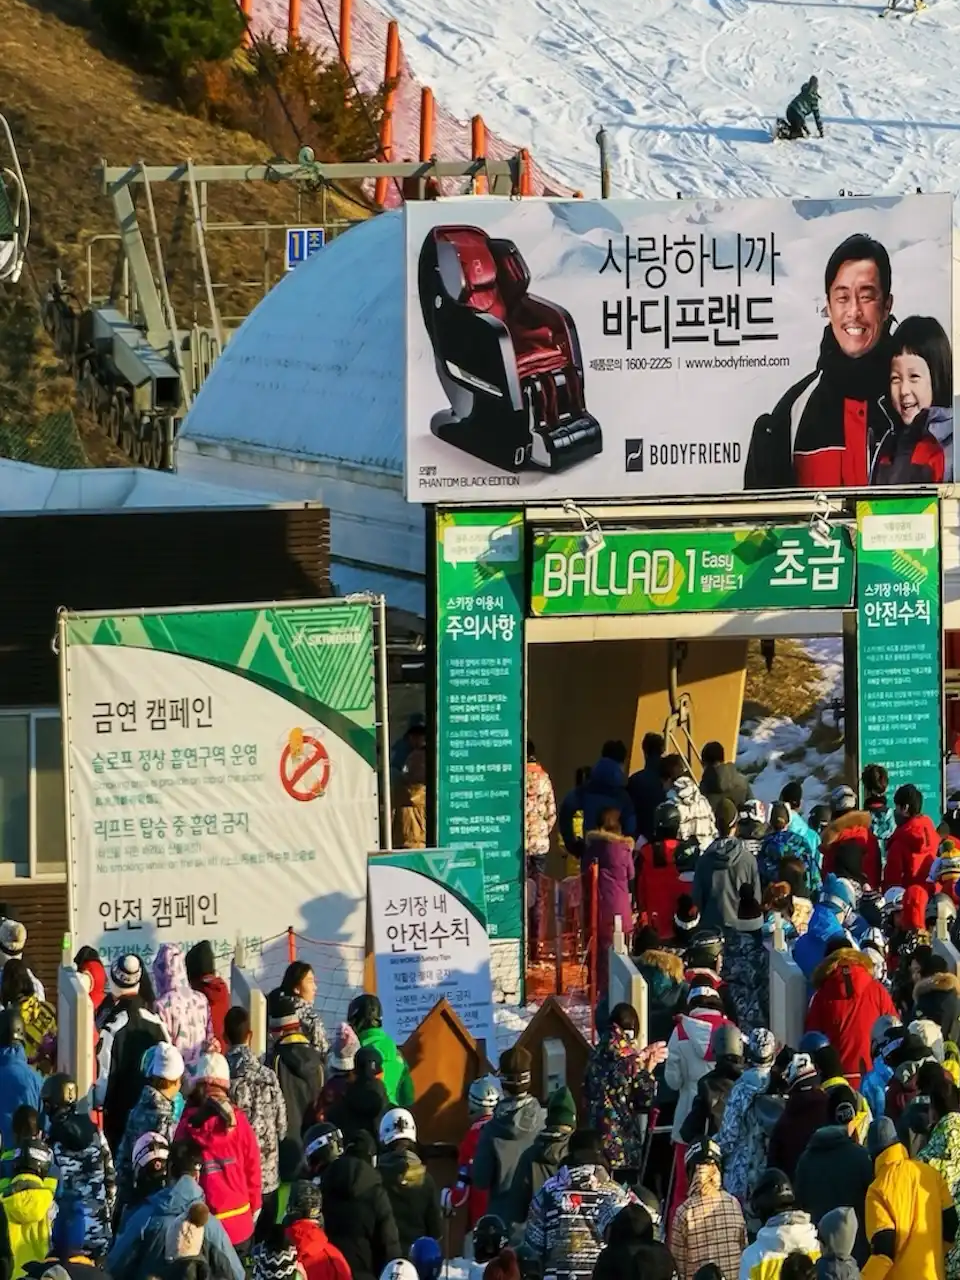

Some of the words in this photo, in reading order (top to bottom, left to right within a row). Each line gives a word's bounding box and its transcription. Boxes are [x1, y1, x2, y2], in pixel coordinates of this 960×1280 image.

[599, 232, 781, 289] 사랑하니까
[602, 293, 779, 351] 바디프랜드
[625, 356, 673, 370] 1600-2225
[685, 354, 790, 370] www.bodyfriend.com
[650, 442, 742, 466] BODYFRIEND
[419, 477, 460, 488] PHANTOM
[461, 477, 488, 487] BLACK
[488, 476, 520, 486] EDITION
[543, 549, 675, 598] BALLAD
[686, 549, 697, 594] 1
[702, 551, 735, 569] Easy
[769, 539, 846, 592] 초급
[701, 574, 743, 594] 발라드1
[865, 583, 892, 597] 스키장
[893, 581, 920, 596] 이용시
[446, 596, 474, 611] 스키장
[475, 595, 504, 610] 이용시
[864, 599, 931, 628] 안전수칙
[445, 614, 516, 642] 주의사항
[92, 700, 137, 734] 금연
[146, 696, 212, 730] 캠페인
[92, 751, 134, 774] 슬로프
[138, 749, 166, 772] 정상
[169, 746, 226, 770] 흡연구역
[230, 744, 258, 766] 운영
[94, 818, 137, 841] 리프트
[139, 817, 168, 839] 탑승
[172, 815, 188, 837] 중
[190, 813, 219, 836] 흡연
[221, 812, 249, 834] 금지
[99, 898, 142, 931] 안전
[152, 893, 219, 928] 캠페인
[384, 895, 428, 917] 스키장
[434, 894, 448, 915] 내
[386, 917, 470, 954] 안전수칙
